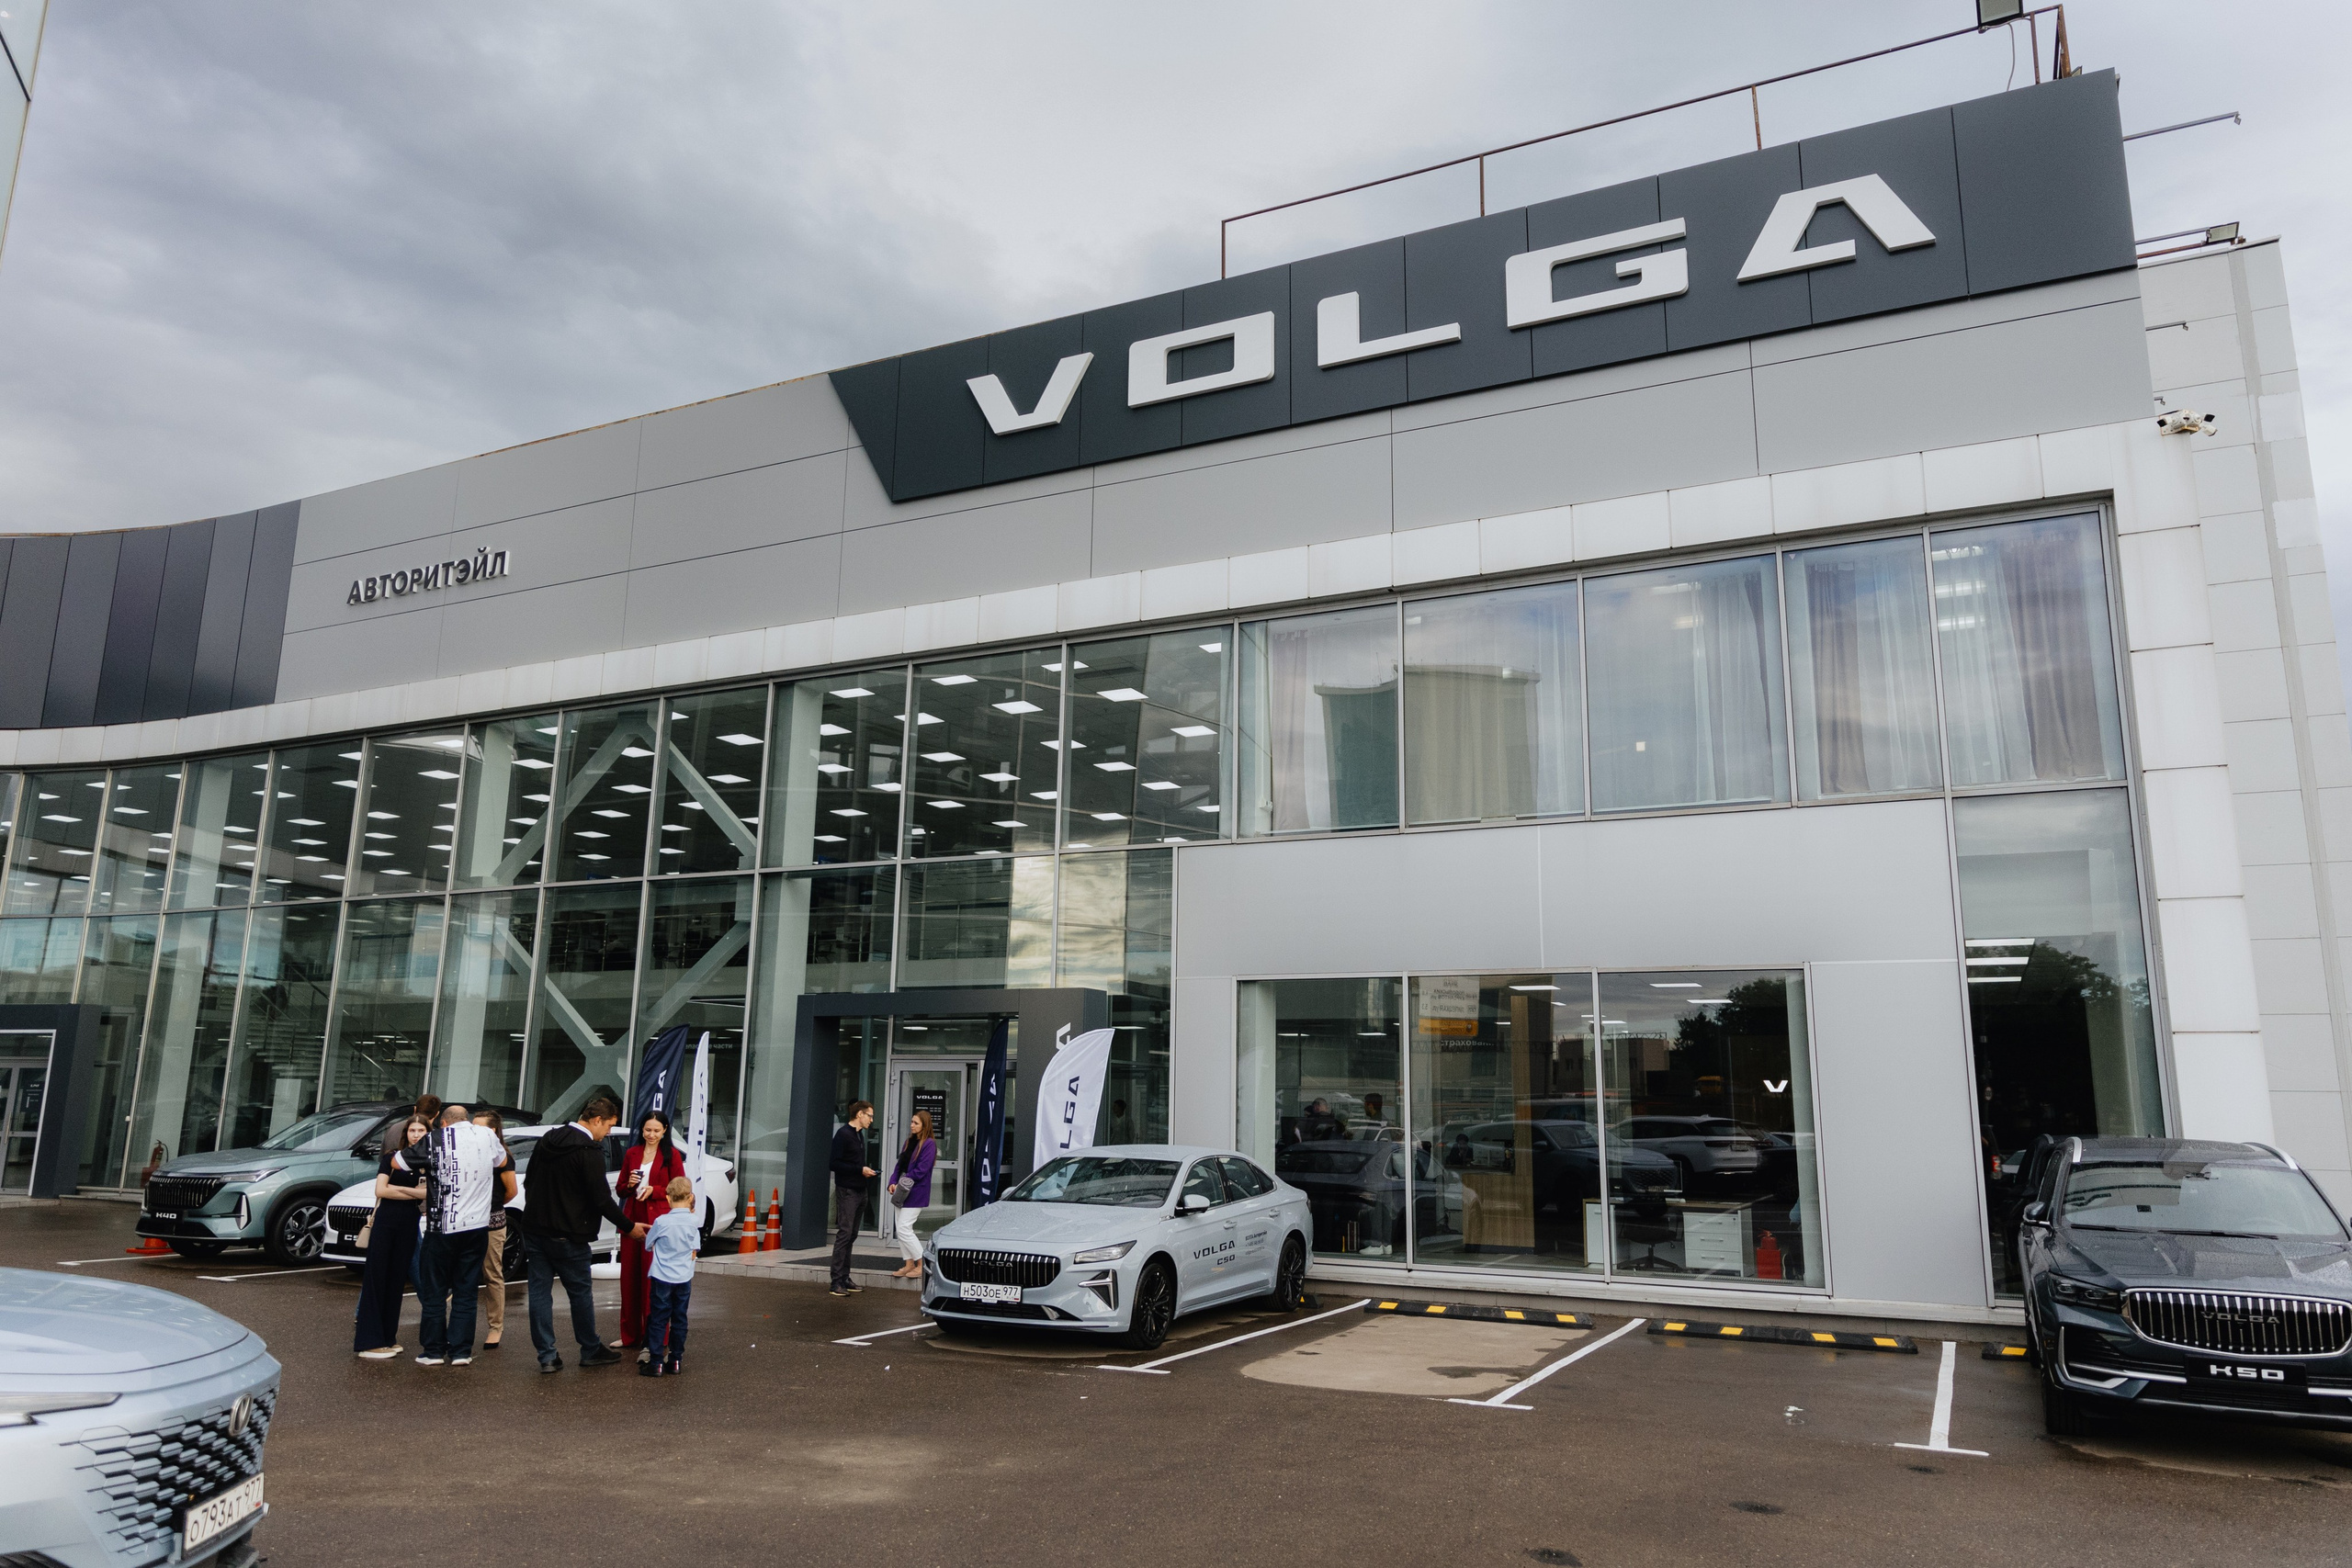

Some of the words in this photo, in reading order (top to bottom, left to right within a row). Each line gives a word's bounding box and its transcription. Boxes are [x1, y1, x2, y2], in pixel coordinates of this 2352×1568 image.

[966, 173, 1937, 436] VOLGA
[346, 547, 511, 605] АВТОРИТЭЙЛ
[1059, 1075, 1080, 1149] LGA
[155, 1212, 177, 1220] K40
[1193, 1240, 1236, 1259] VOLGA
[1216, 1254, 1236, 1266] C50
[1002, 1286, 1019, 1296] 977
[2200, 1311, 2280, 1324] VOLGA
[2210, 1365, 2285, 1381] K50
[244, 1477, 262, 1506] 977
